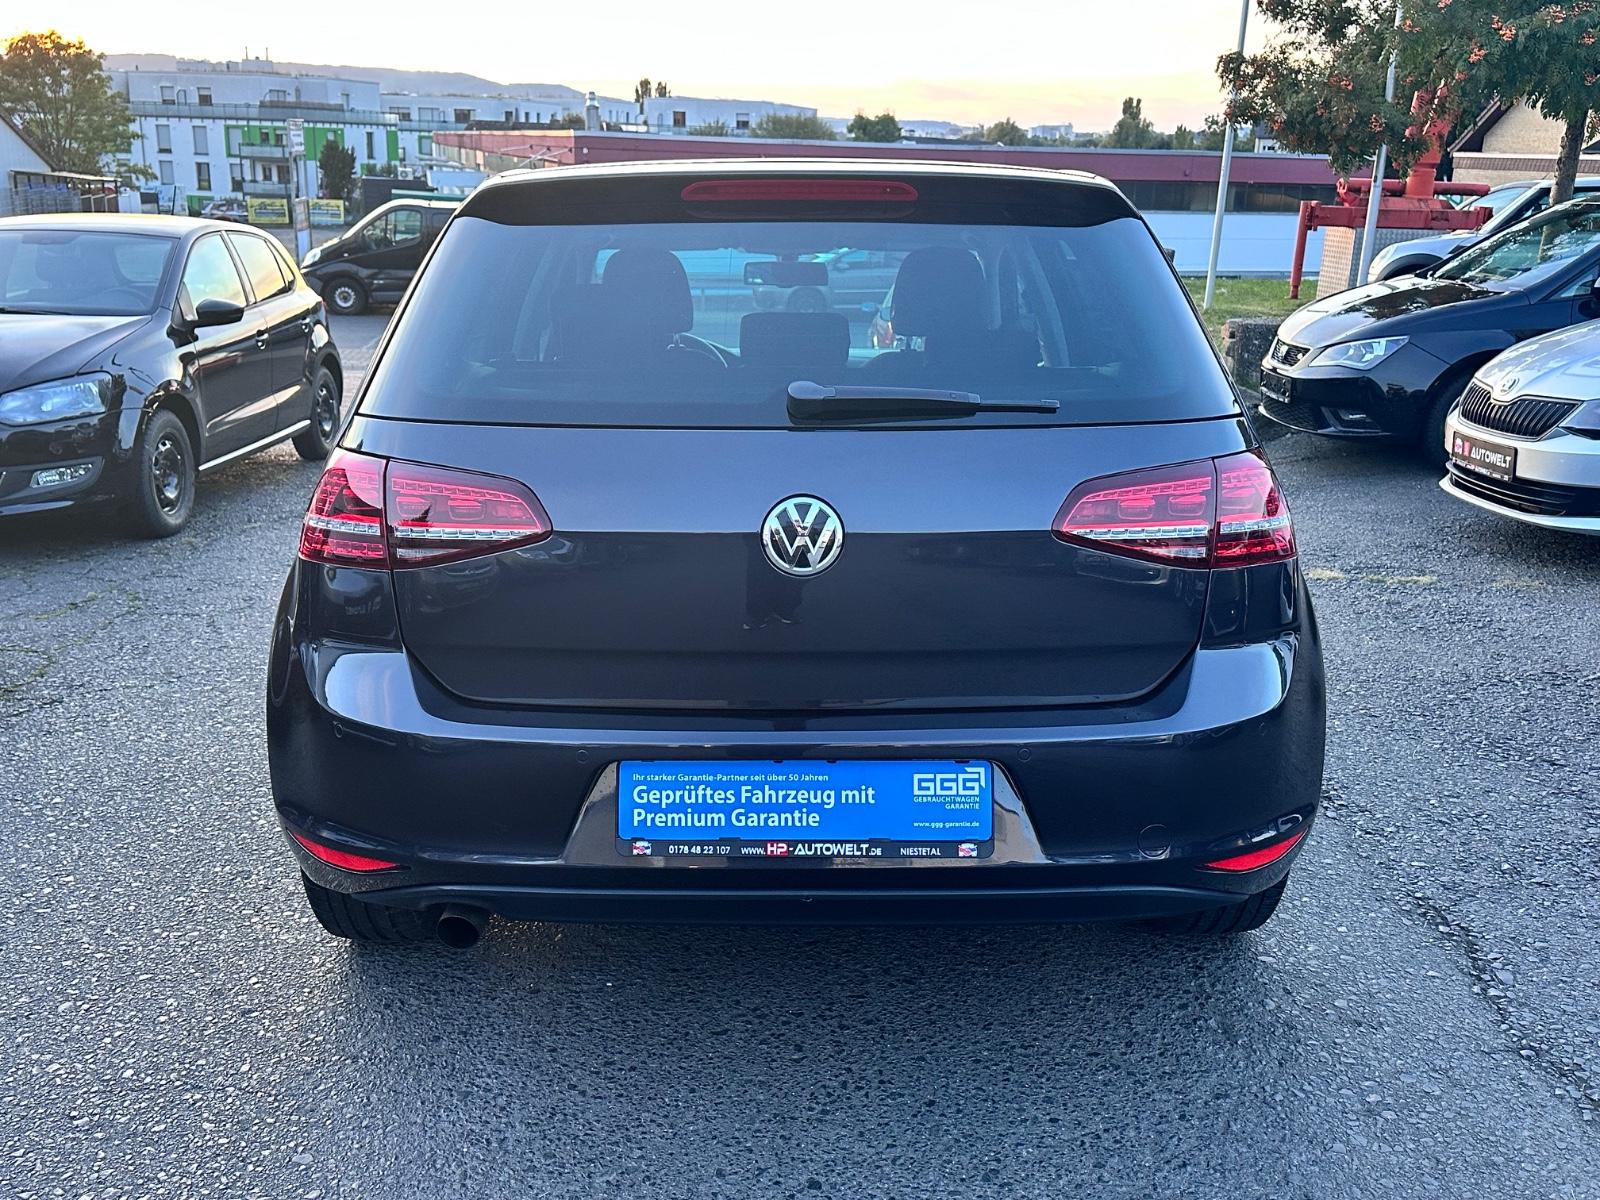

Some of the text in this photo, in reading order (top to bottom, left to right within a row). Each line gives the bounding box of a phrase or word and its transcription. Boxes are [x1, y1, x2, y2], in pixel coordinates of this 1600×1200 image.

[1470, 446, 1512, 468] AUTOWELT
[763, 496, 844, 575] VW
[633, 773, 829, 782] Ihr starker Garantie-Partner seit über 50 Jahren
[913, 773, 980, 795] GGG
[632, 784, 876, 809] Geprüftes Fahrzeug mit
[633, 808, 820, 827] Premium Garantie
[913, 821, 980, 829] www.ggg-garantie.de
[668, 845, 689, 854] 0178
[690, 846, 702, 854] 48
[702, 846, 714, 854] 22
[716, 846, 731, 854] 107
[900, 847, 941, 856] NIESTETAL
